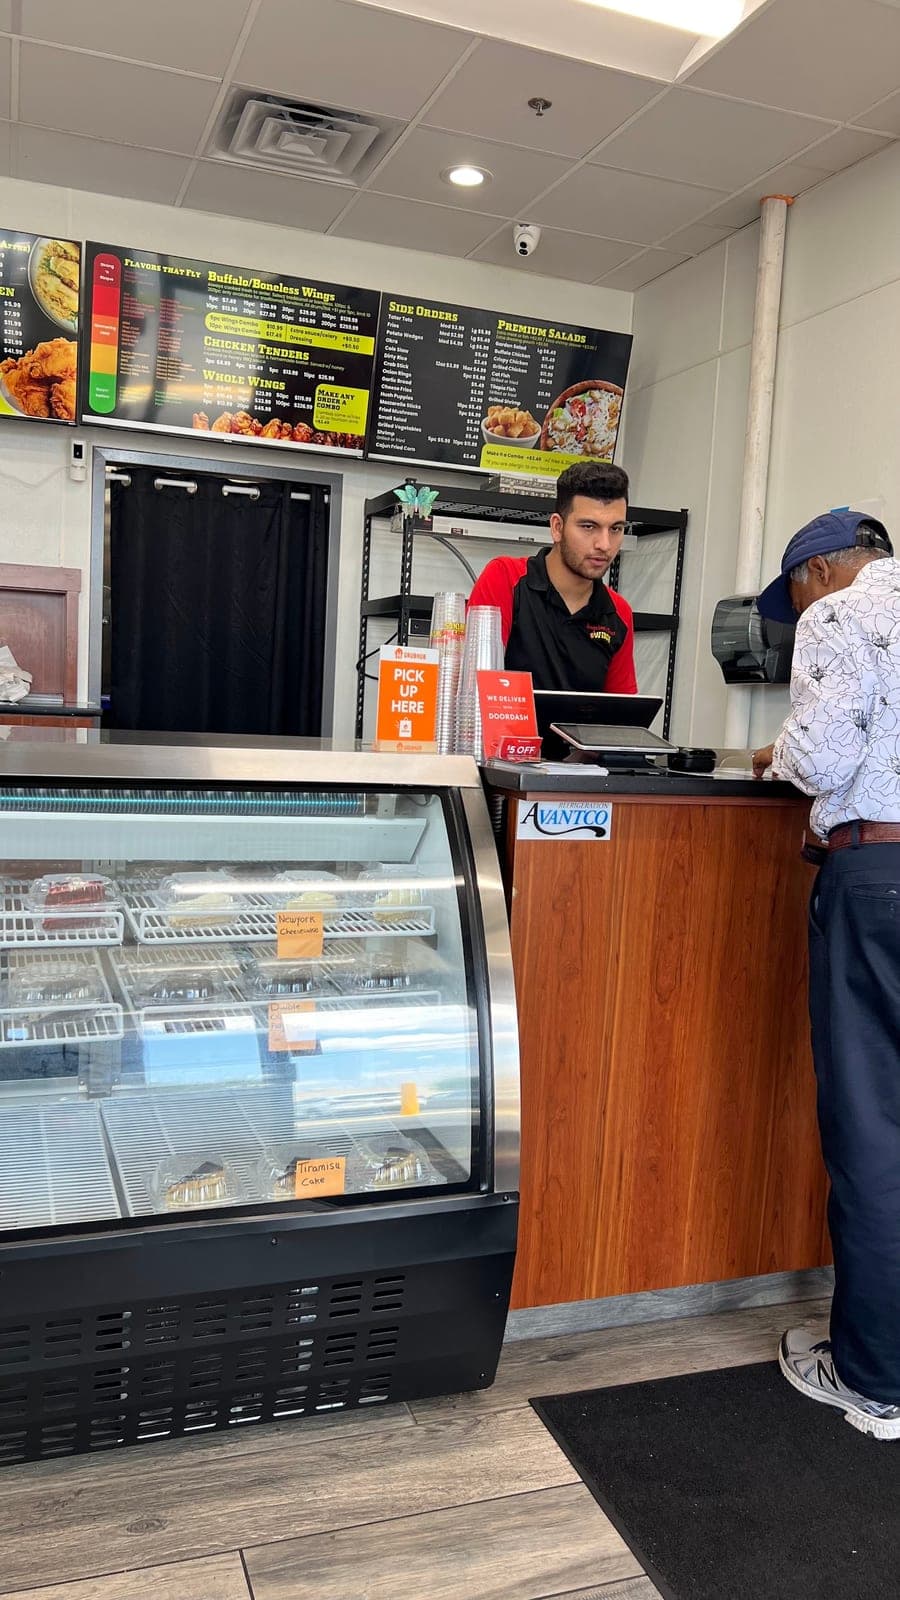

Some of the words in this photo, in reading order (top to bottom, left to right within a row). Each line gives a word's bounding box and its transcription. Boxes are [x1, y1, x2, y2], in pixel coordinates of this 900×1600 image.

[125, 258, 161, 272] FLAVORS
[163, 266, 182, 275] THAT
[185, 269, 201, 279] FLY
[208, 271, 300, 296] Buffalo/Boneless
[302, 287, 335, 303] Wings
[389, 301, 414, 314] SIDE
[416, 306, 458, 321] ORDERS
[497, 319, 547, 337] PREMIUM
[549, 328, 587, 344] SALADS
[290, 335, 312, 344] Dressing
[404, 333, 424, 341] Wedges
[204, 336, 256, 352] CHICKEN
[258, 344, 310, 361] TENDERS
[203, 370, 245, 385] WHOLE
[248, 376, 286, 391] WINGS
[318, 390, 339, 398] MAKE
[317, 397, 340, 405] ORDER
[380, 399, 406, 407] Mozzarella
[504, 399, 521, 407] Shrimp
[316, 403, 340, 411] COMBO
[377, 429, 395, 437] Shrimp
[395, 425, 422, 433] Vegetables
[394, 668, 424, 683] PICK
[400, 684, 418, 697] UP
[499, 695, 526, 703] DELIVER
[391, 700, 425, 714] HERE
[488, 713, 529, 721] DOORDASH
[516, 746, 536, 755] OFF
[520, 802, 608, 829] AVANTCO
[298, 1161, 341, 1173] Tiramisu
[301, 1177, 325, 1187] Cake
